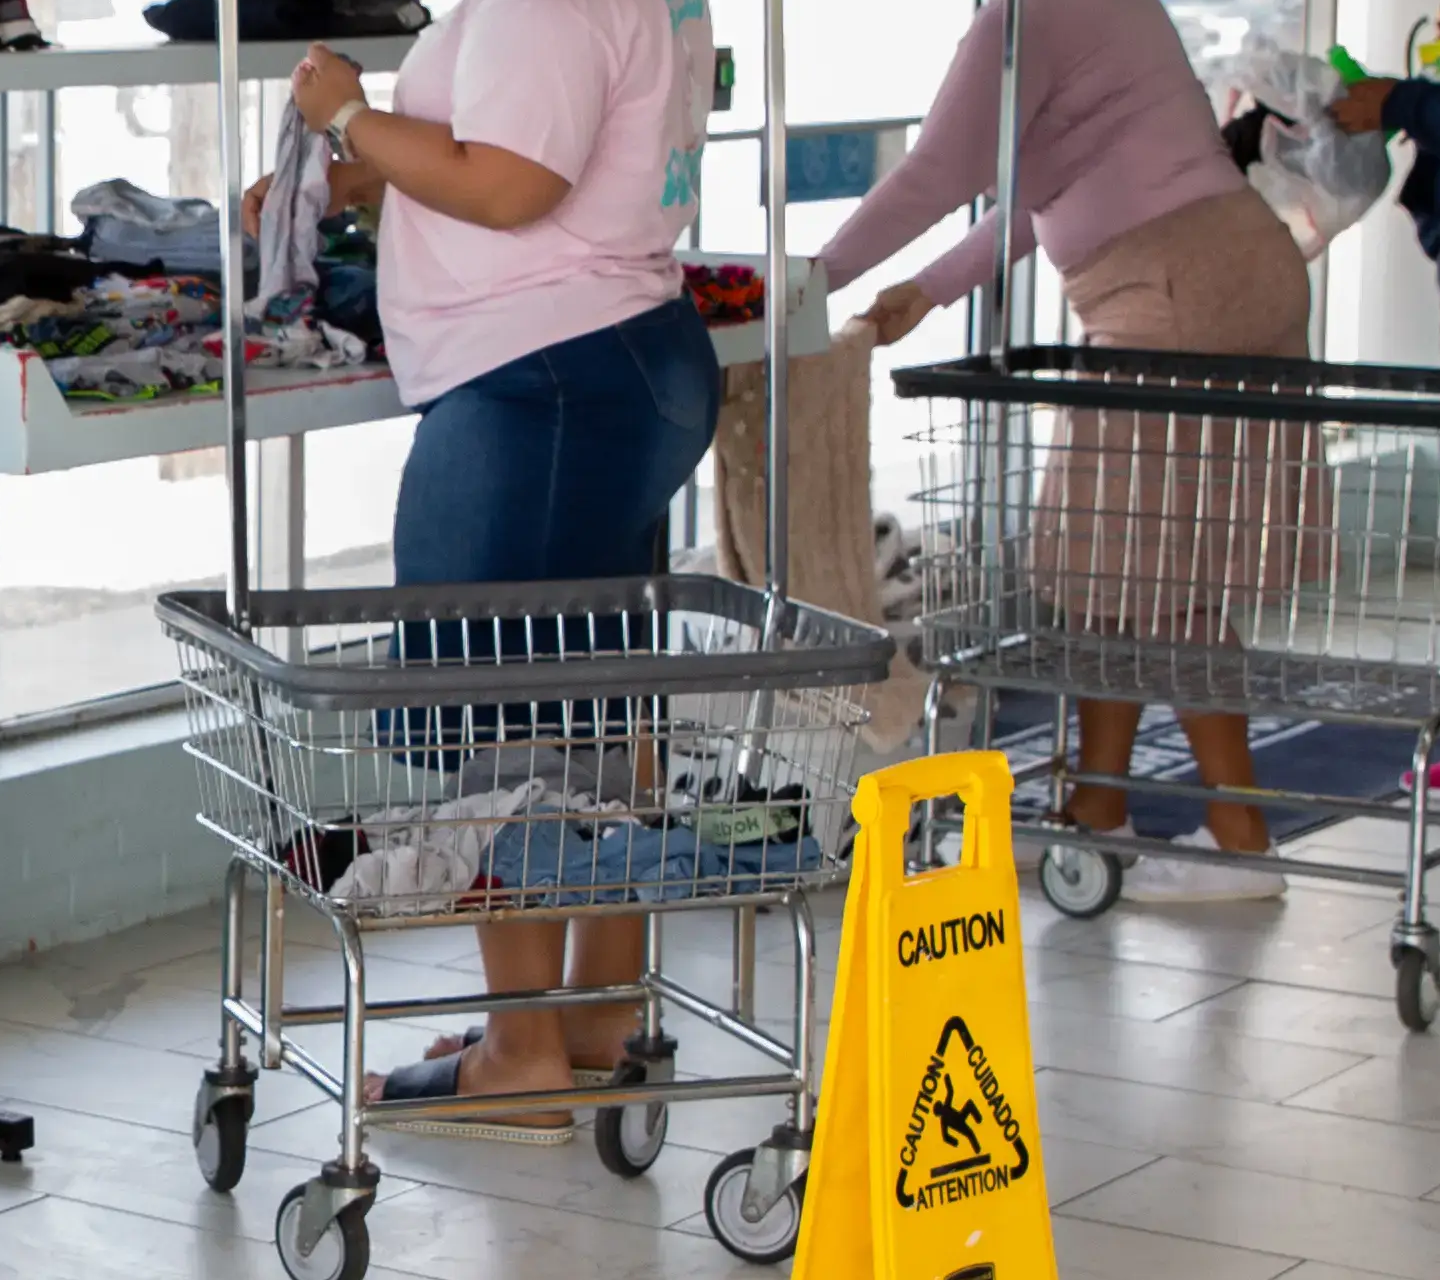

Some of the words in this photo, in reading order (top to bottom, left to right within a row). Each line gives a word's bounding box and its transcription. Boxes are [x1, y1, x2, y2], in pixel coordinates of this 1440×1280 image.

[898, 909, 1004, 967] CAUTION
[900, 1055, 945, 1166] CAUTION
[968, 1045, 1020, 1142] CUIDADO
[917, 1165, 1008, 1211] ATTENTION
